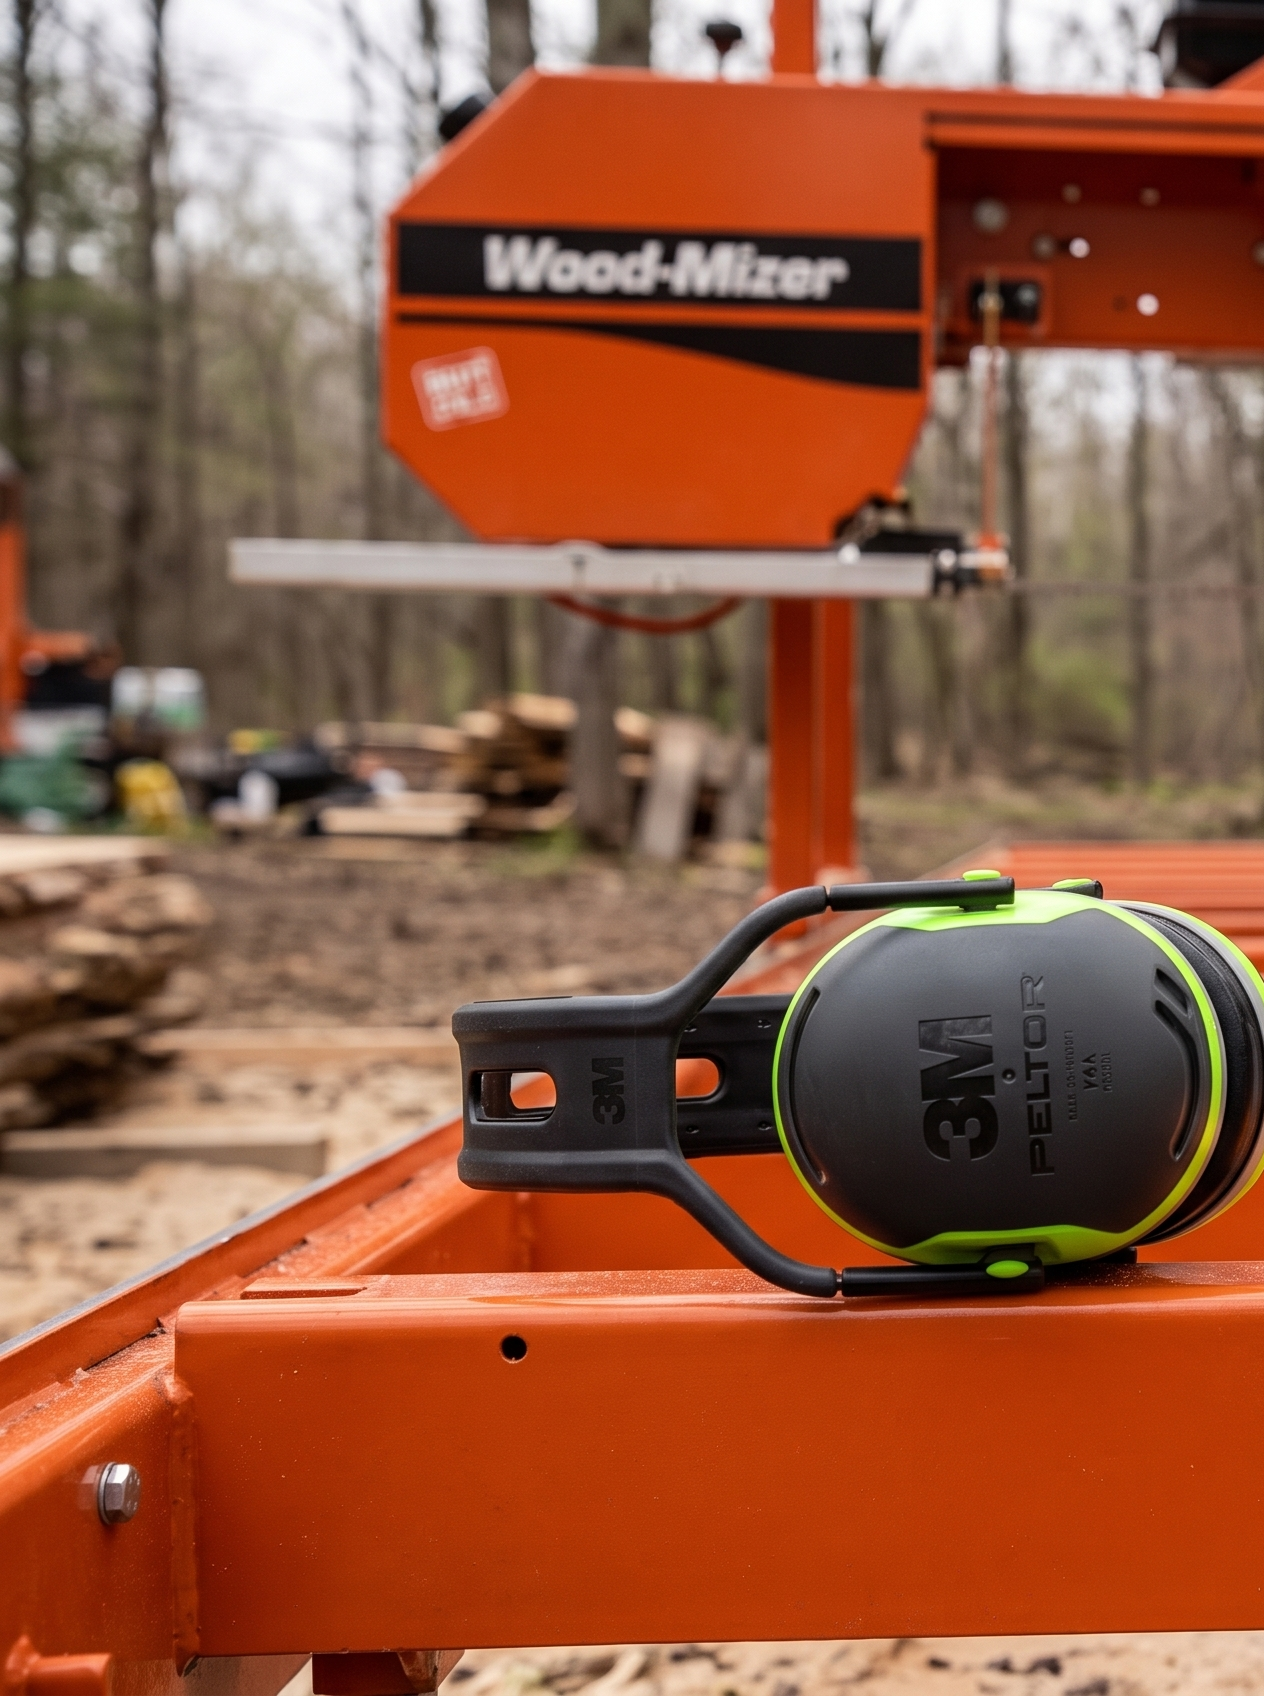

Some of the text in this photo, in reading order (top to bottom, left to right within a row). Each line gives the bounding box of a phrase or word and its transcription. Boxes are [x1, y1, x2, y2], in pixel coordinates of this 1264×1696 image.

[483, 234, 849, 299] Wood-Mizer
[591, 1057, 626, 1125] 3M
[918, 1014, 999, 1162] 3M
[1020, 975, 1055, 1176] PELTOR
